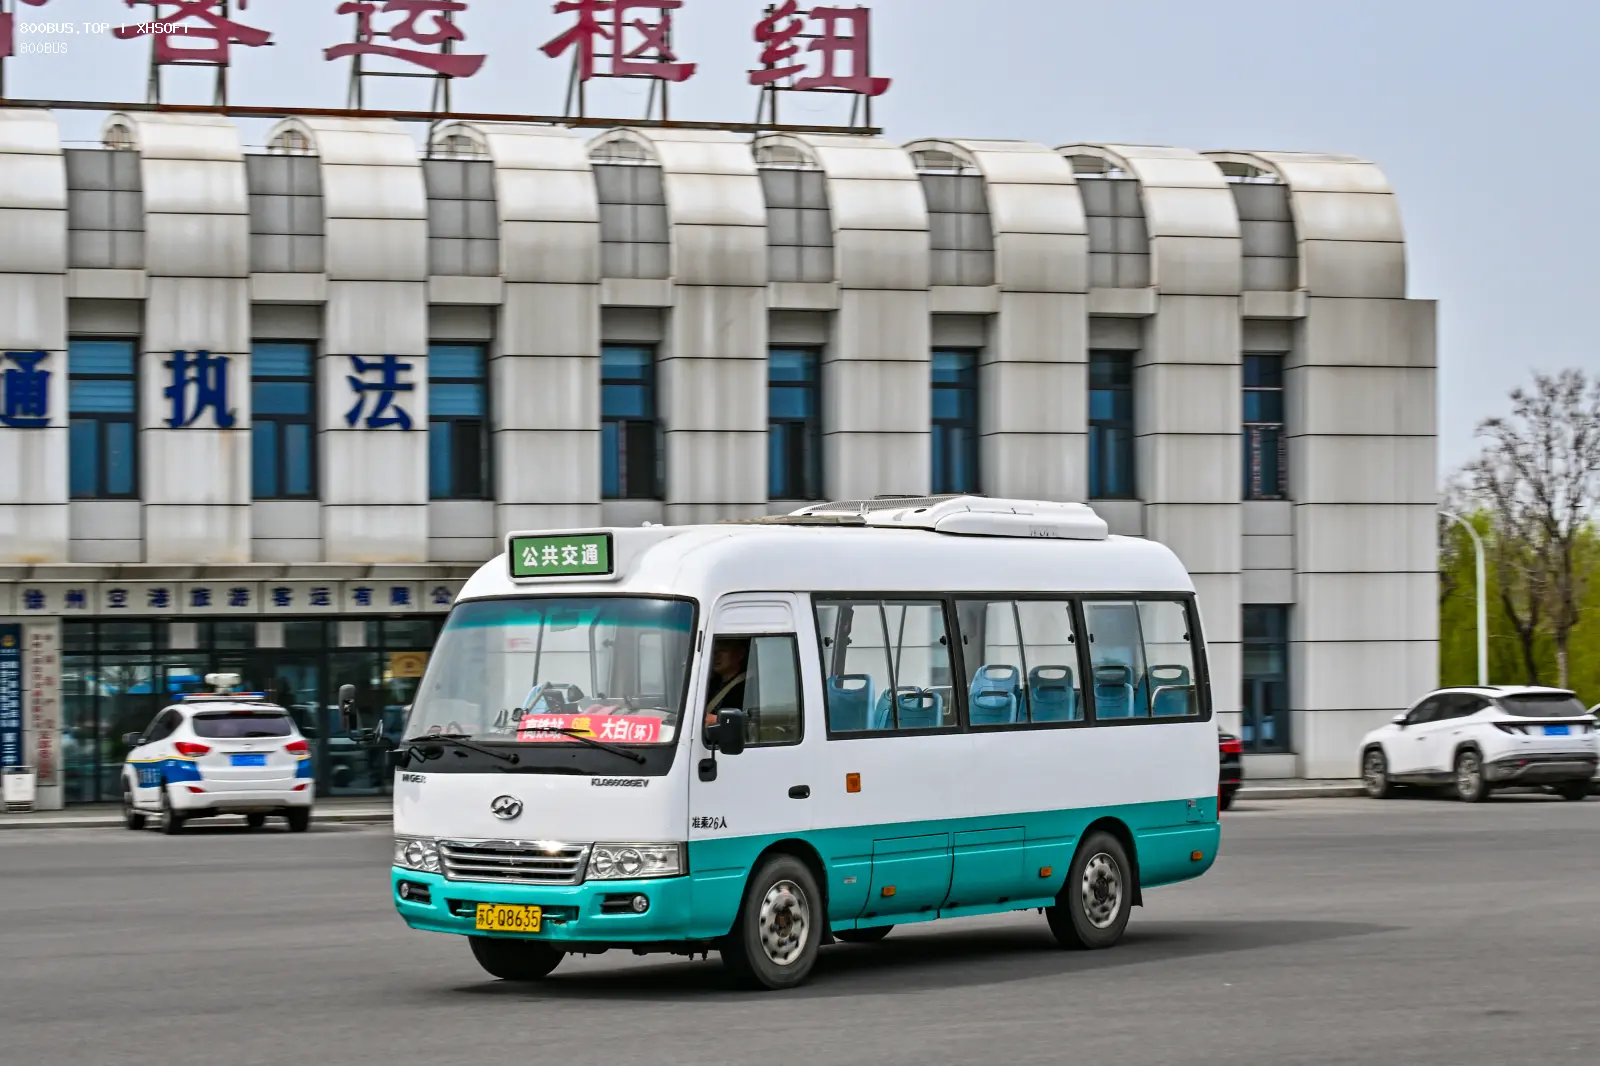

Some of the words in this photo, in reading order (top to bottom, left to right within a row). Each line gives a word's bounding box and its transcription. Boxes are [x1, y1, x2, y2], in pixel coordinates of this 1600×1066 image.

[0, 0, 892, 96] 客运枢纽
[522, 543, 599, 567] 公共交通
[600, 718, 653, 741] 大白(环)
[691, 815, 728, 830] 准乘26人
